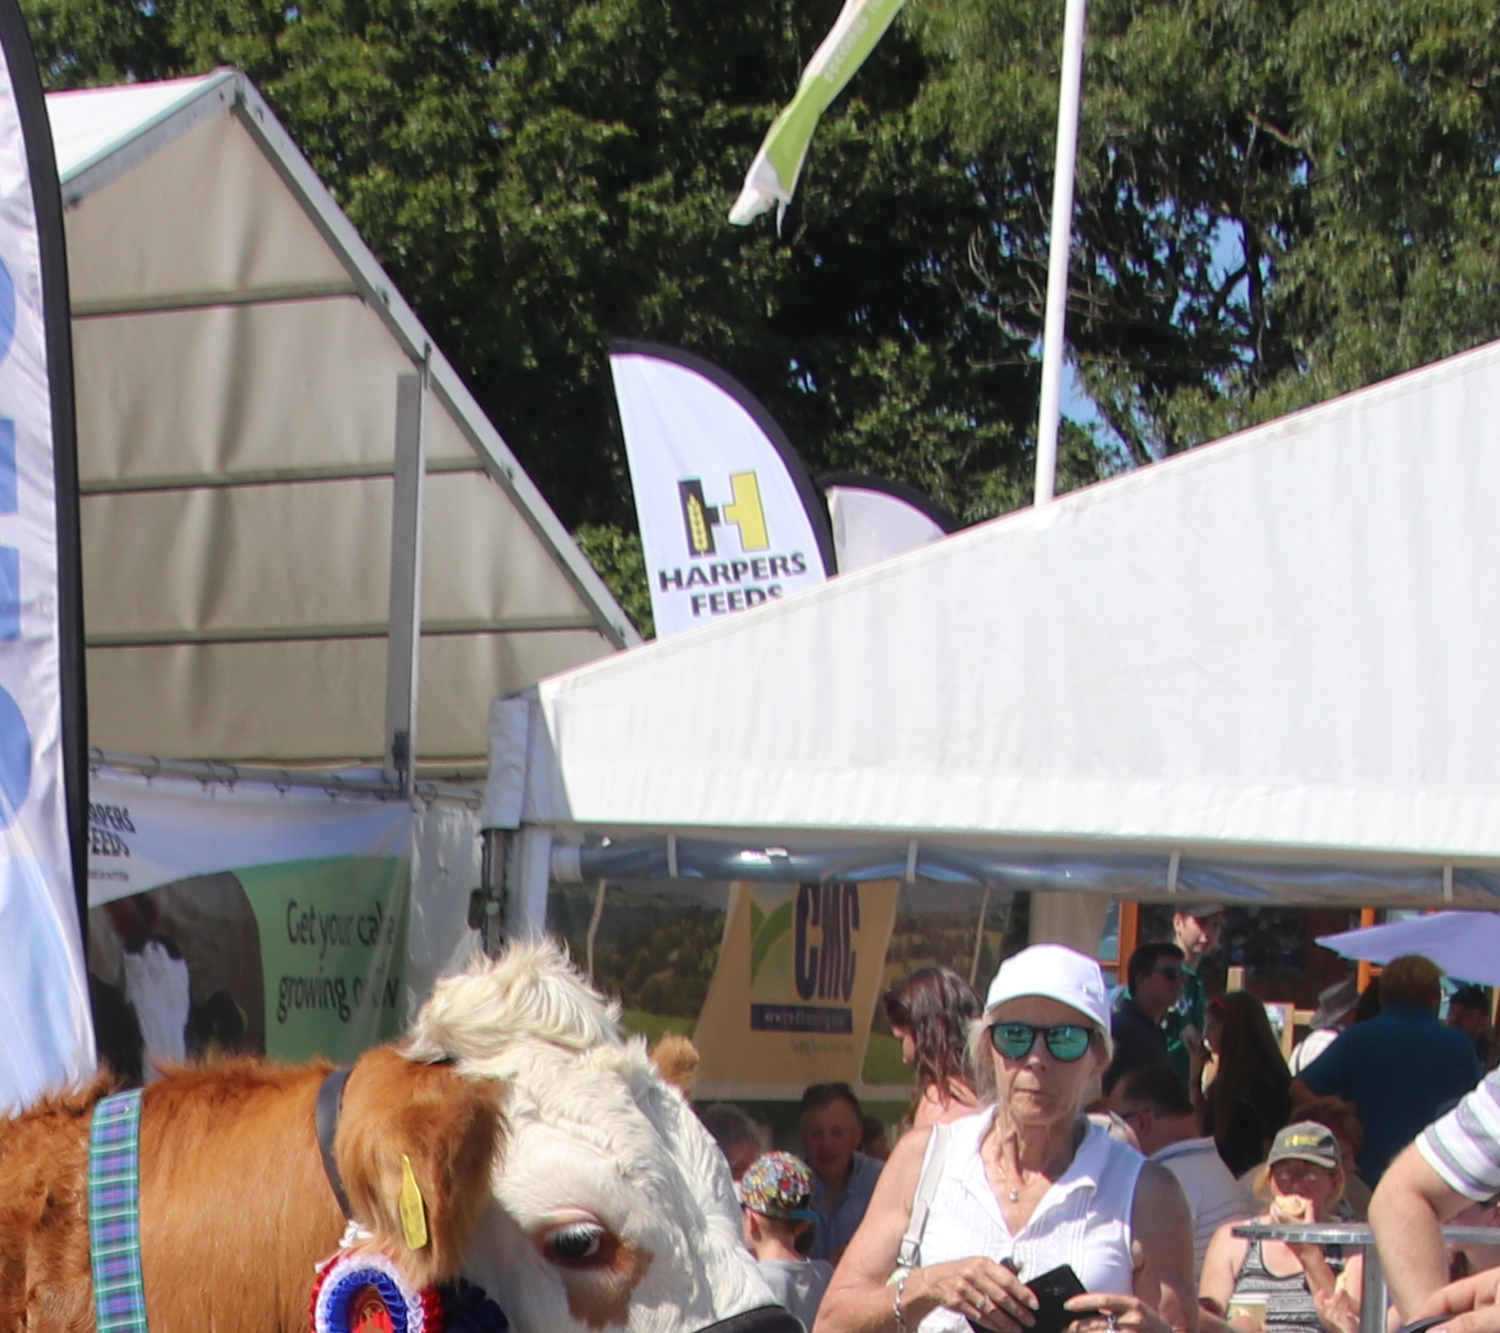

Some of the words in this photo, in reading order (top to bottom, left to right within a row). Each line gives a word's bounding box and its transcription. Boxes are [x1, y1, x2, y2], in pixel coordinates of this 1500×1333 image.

[658, 552, 807, 593] HARPERS
[690, 585, 783, 617] FEEDS
[286, 900, 315, 945] Get
[319, 913, 354, 960] your
[277, 963, 351, 1023] growing
